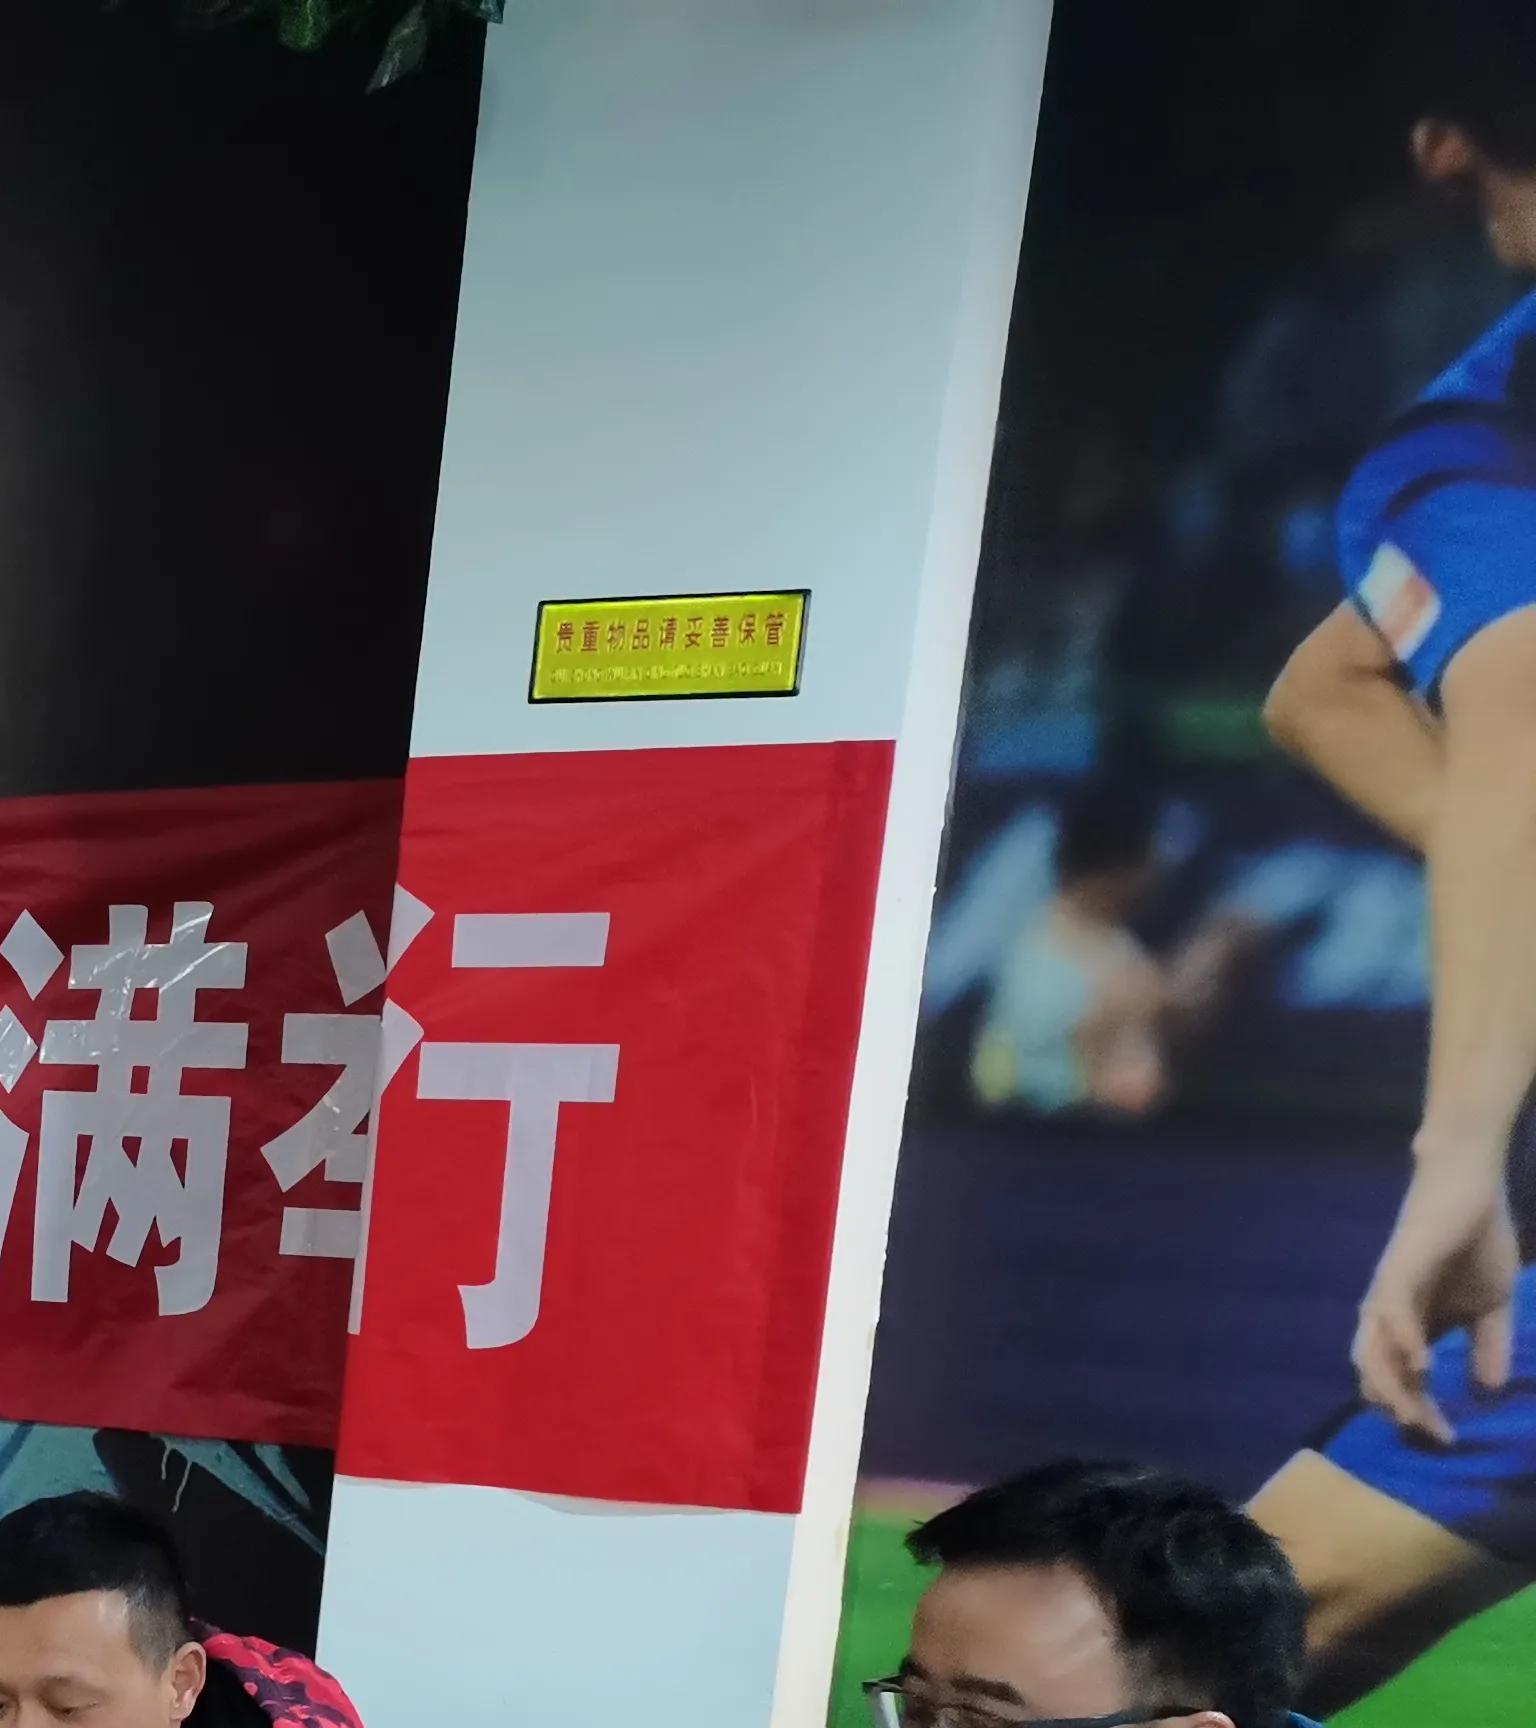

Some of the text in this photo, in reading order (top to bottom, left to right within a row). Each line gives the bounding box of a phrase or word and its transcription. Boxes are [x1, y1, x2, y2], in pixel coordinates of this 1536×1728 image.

[555, 611, 786, 654] 贵重物品请妥善保管
